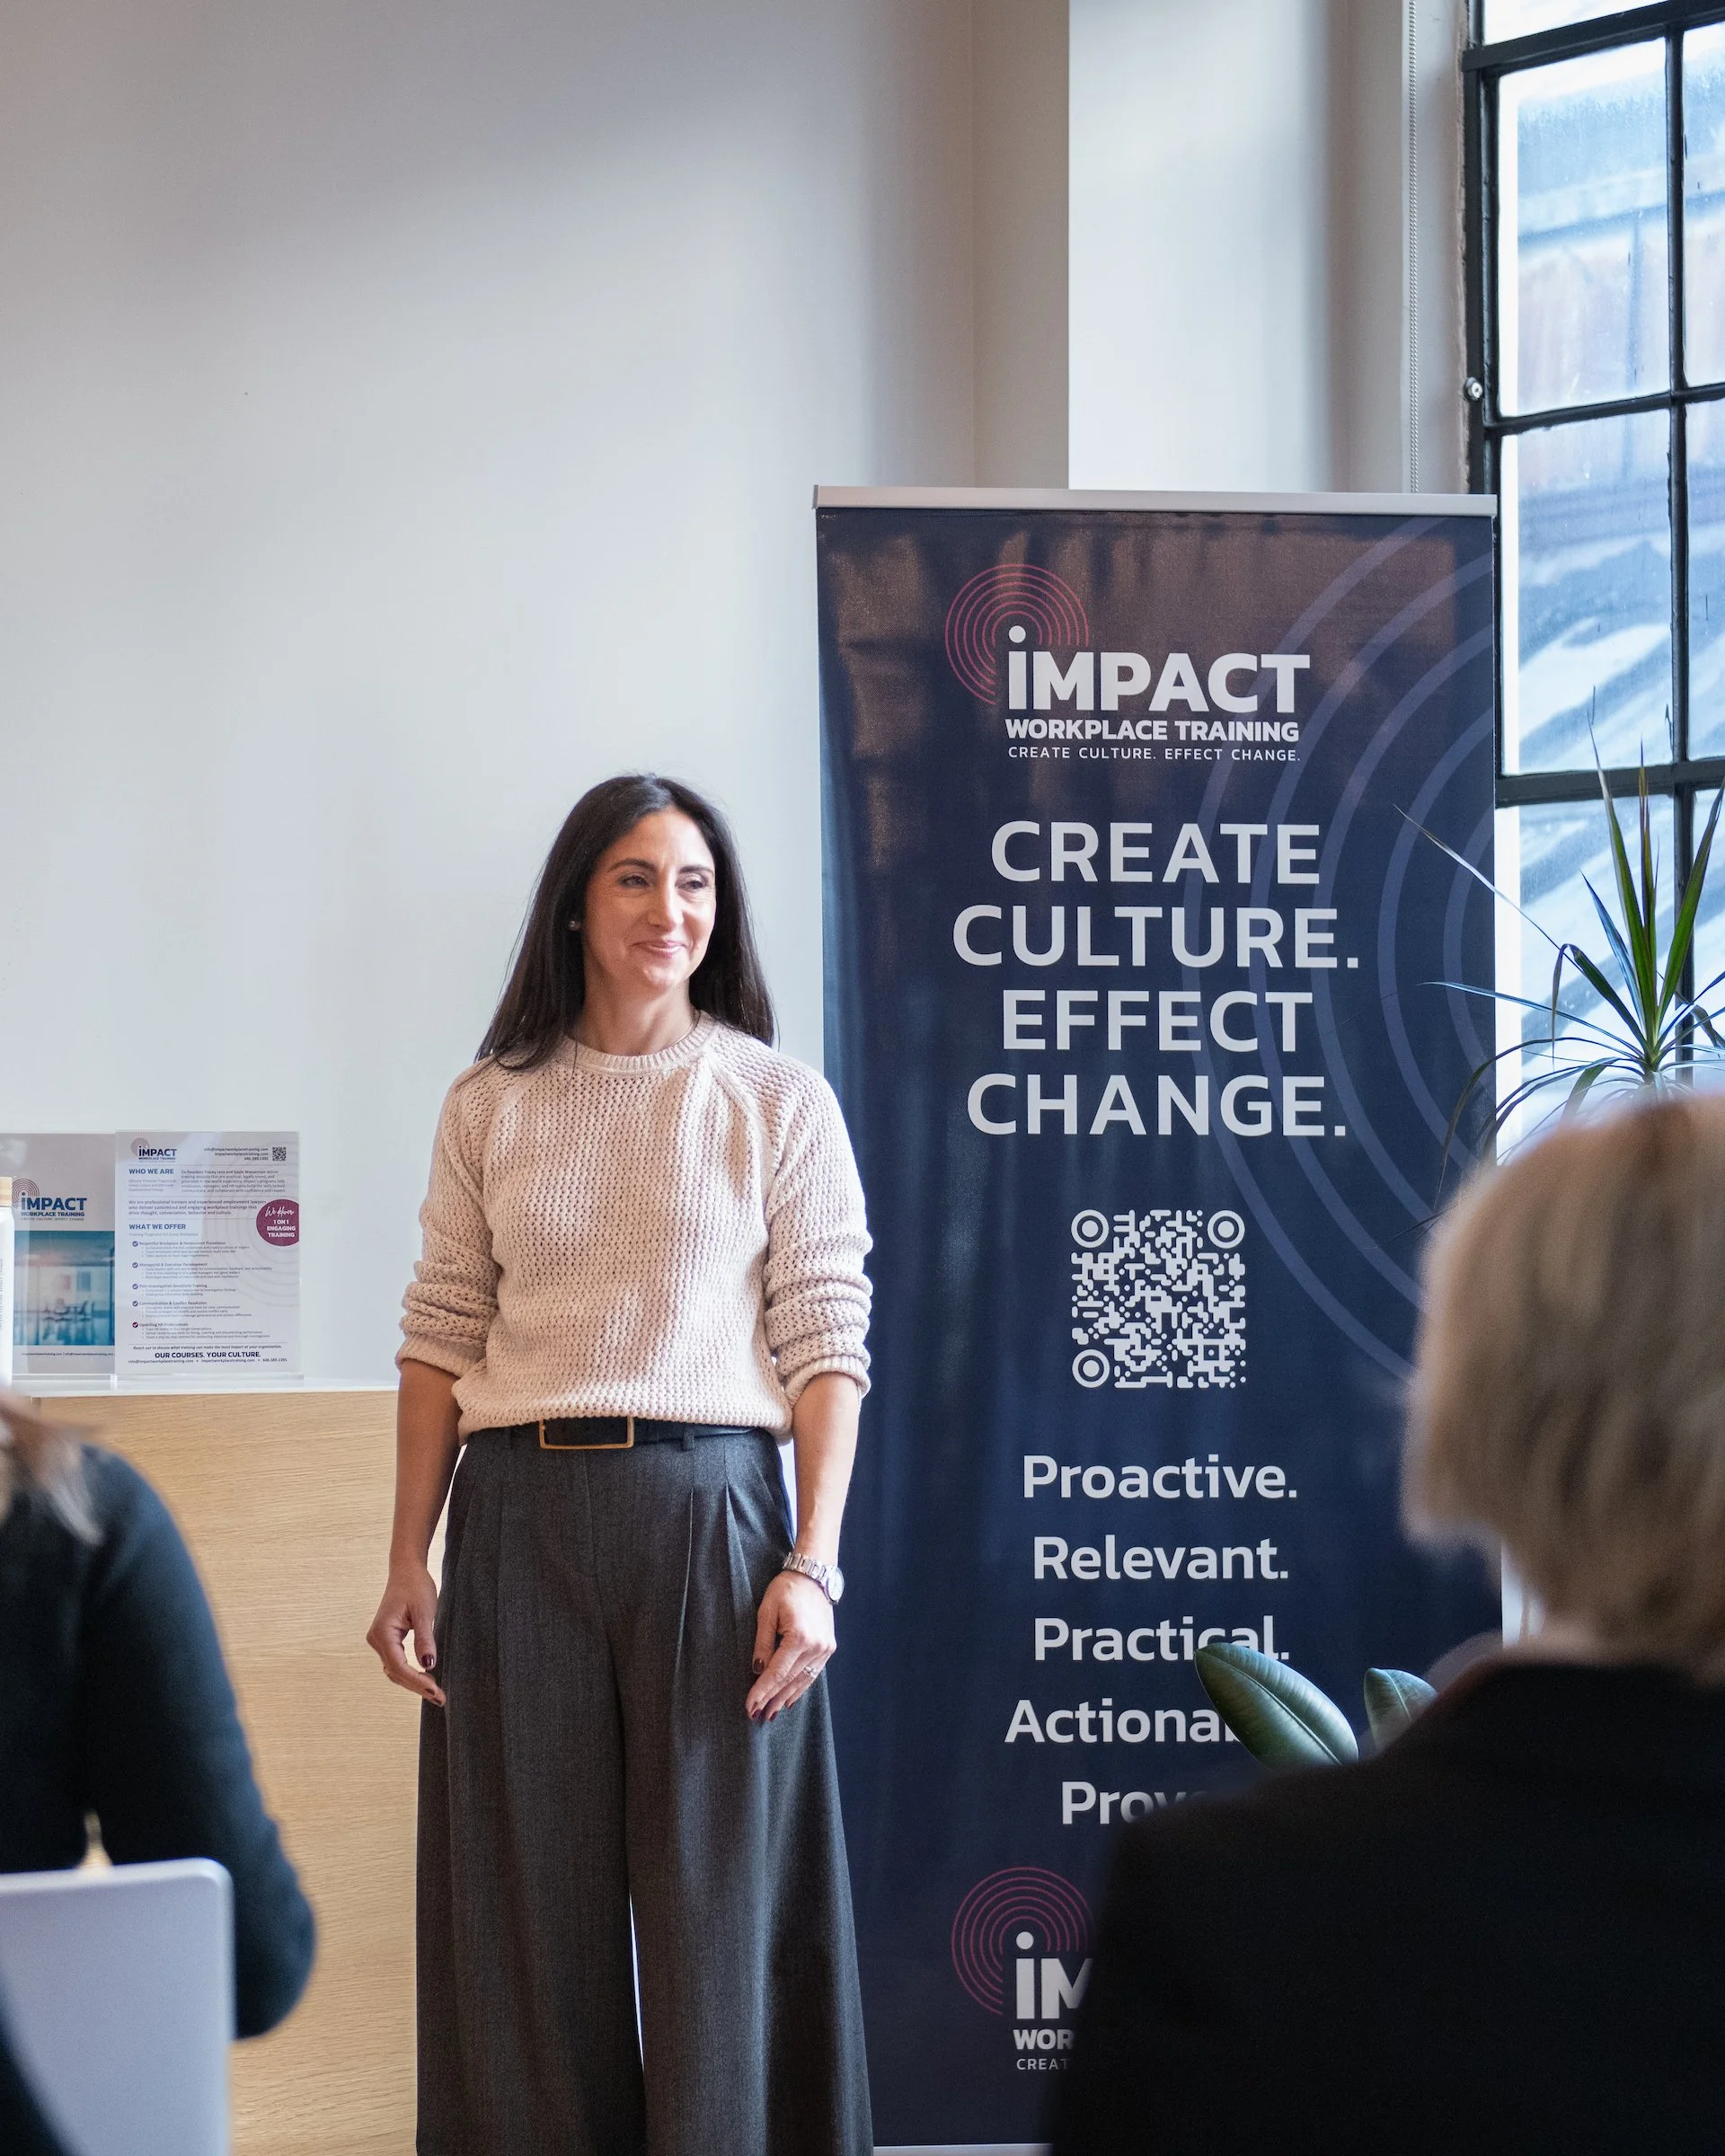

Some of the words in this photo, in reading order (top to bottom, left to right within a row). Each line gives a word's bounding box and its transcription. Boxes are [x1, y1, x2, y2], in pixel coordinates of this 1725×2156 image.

[1004, 718, 1168, 742] WORKPLACE
[1173, 720, 1299, 744] TRAINING
[1008, 746, 1070, 760] CREATE
[1078, 747, 1156, 761] CULTURE.
[1164, 747, 1223, 761] EFFECT
[1231, 748, 1301, 762] CHANGE.
[991, 820, 1320, 885] CREATE
[952, 904, 1359, 969] CULTURE.
[1003, 989, 1314, 1054] EFFECT
[967, 1073, 1347, 1138] CHANGE.
[1023, 1454, 1297, 1499] Proactive.
[1033, 1534, 1289, 1580] Relevant.
[1004, 1697, 1242, 1744] Actiona
